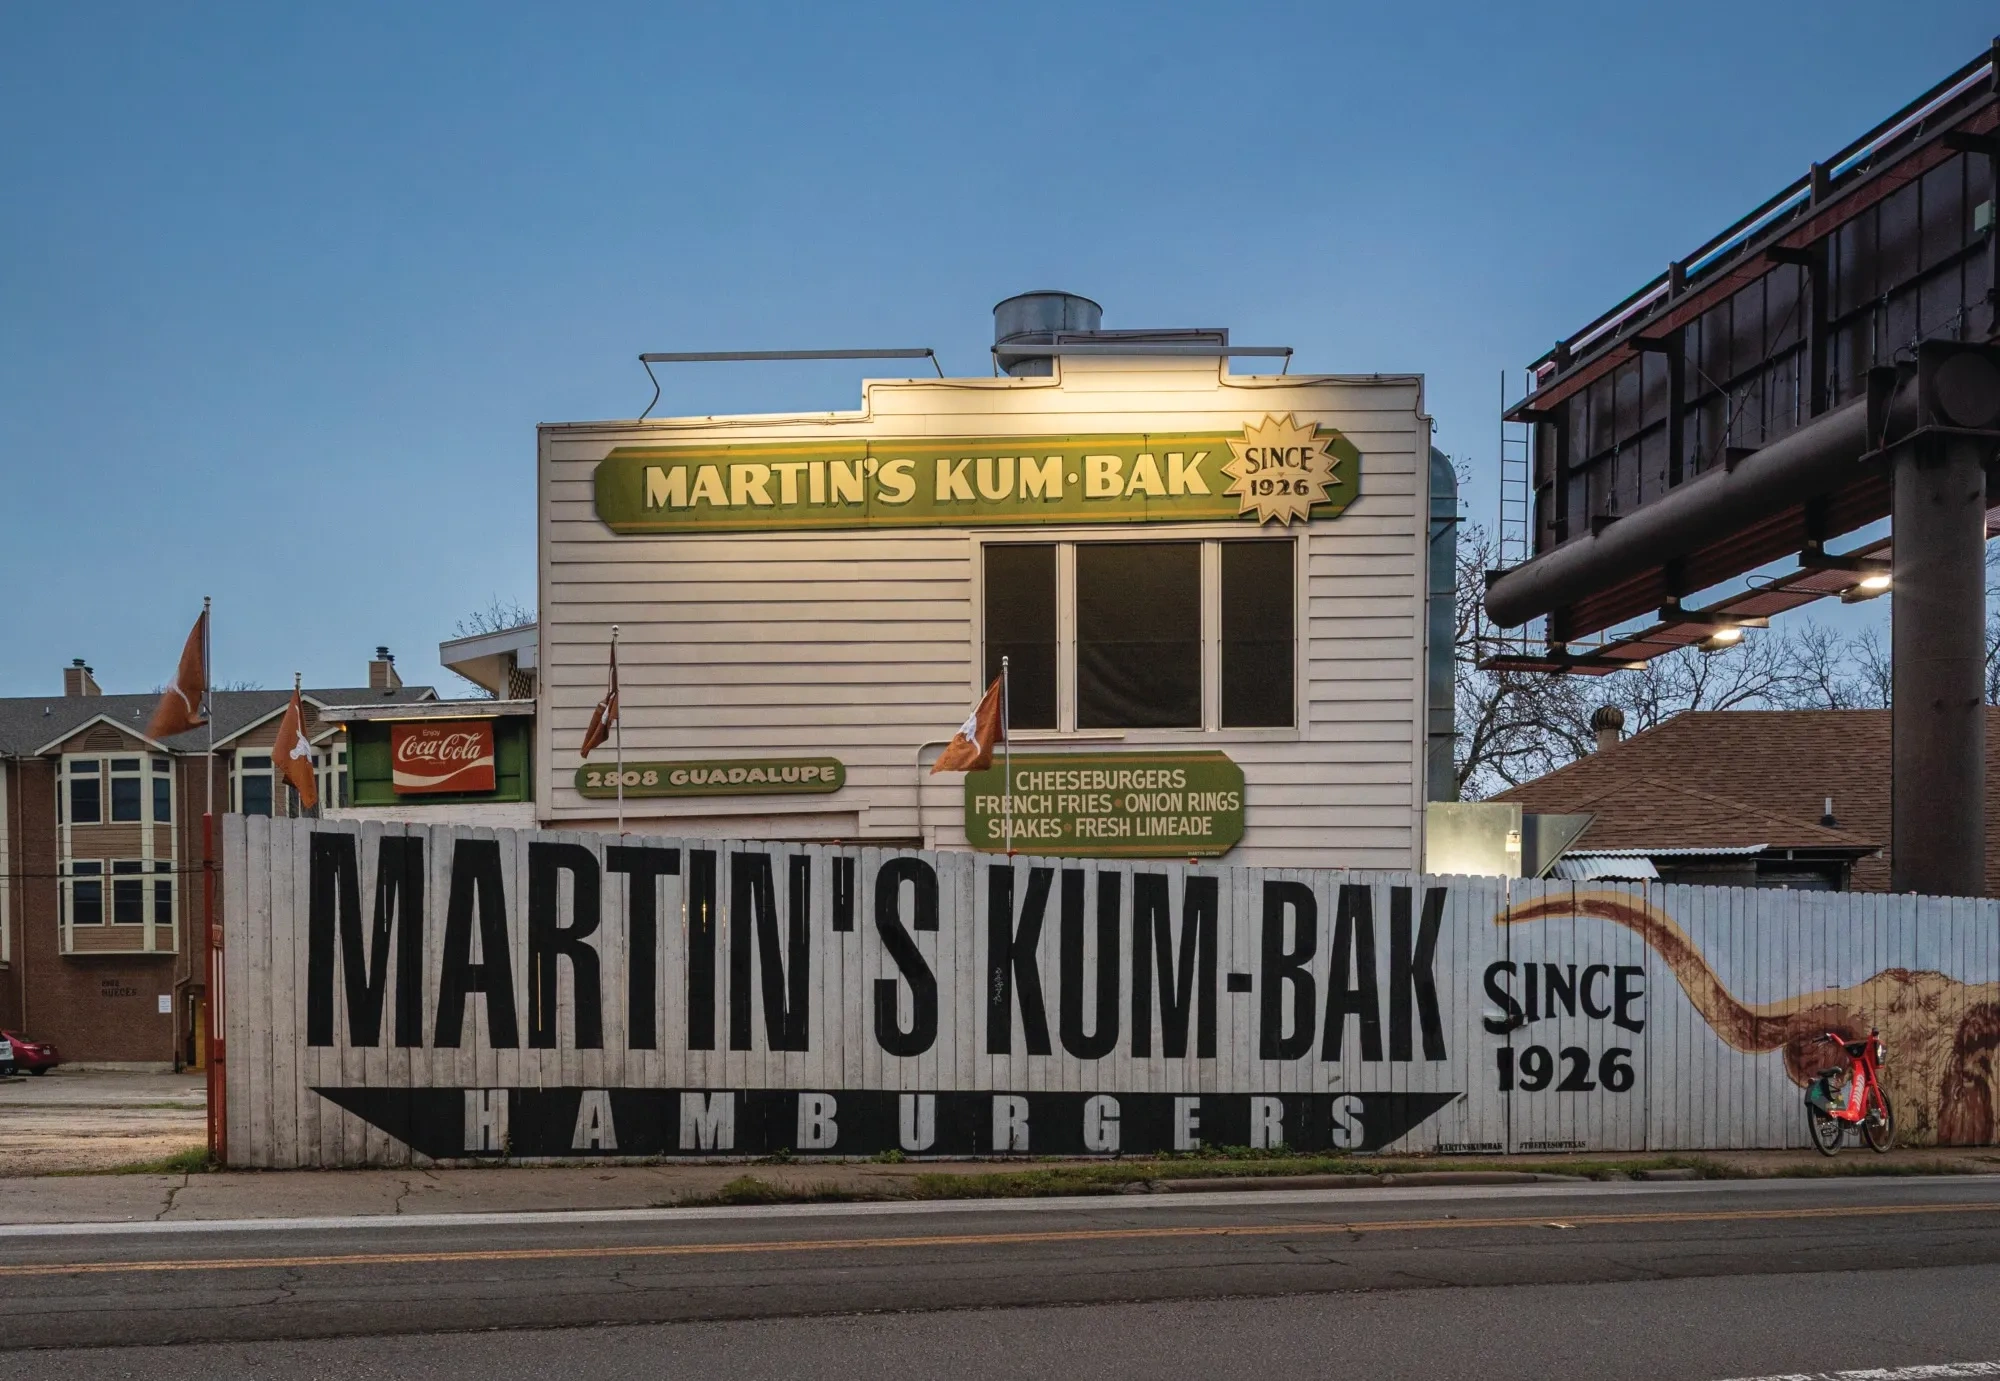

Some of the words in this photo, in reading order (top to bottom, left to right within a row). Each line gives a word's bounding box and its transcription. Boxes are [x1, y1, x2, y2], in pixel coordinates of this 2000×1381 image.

[1244, 446, 1315, 475] SINCE
[645, 457, 917, 508] MARTIN'S
[1250, 478, 1310, 497] 1926
[397, 731, 483, 762] Coca-Cola
[586, 770, 659, 788] 2808
[669, 766, 836, 786] GUADALUPE
[1015, 769, 1187, 791] CHEESEBURGERS
[974, 795, 1052, 815] FRENCH
[1057, 794, 1113, 814] FRIES
[1124, 793, 1183, 813] ONION
[1187, 791, 1240, 812] RINGS
[987, 818, 1063, 838] SHAKES
[1075, 817, 1131, 838] FRESH
[1136, 816, 1213, 837] LIMEADE
[307, 831, 940, 1058] MARTIN'S
[986, 864, 1448, 1063] KUM-BAK
[1482, 960, 1646, 1036] SINCE
[1497, 1044, 1636, 1093] 1926
[463, 1089, 1365, 1153] HAMBURGERS
